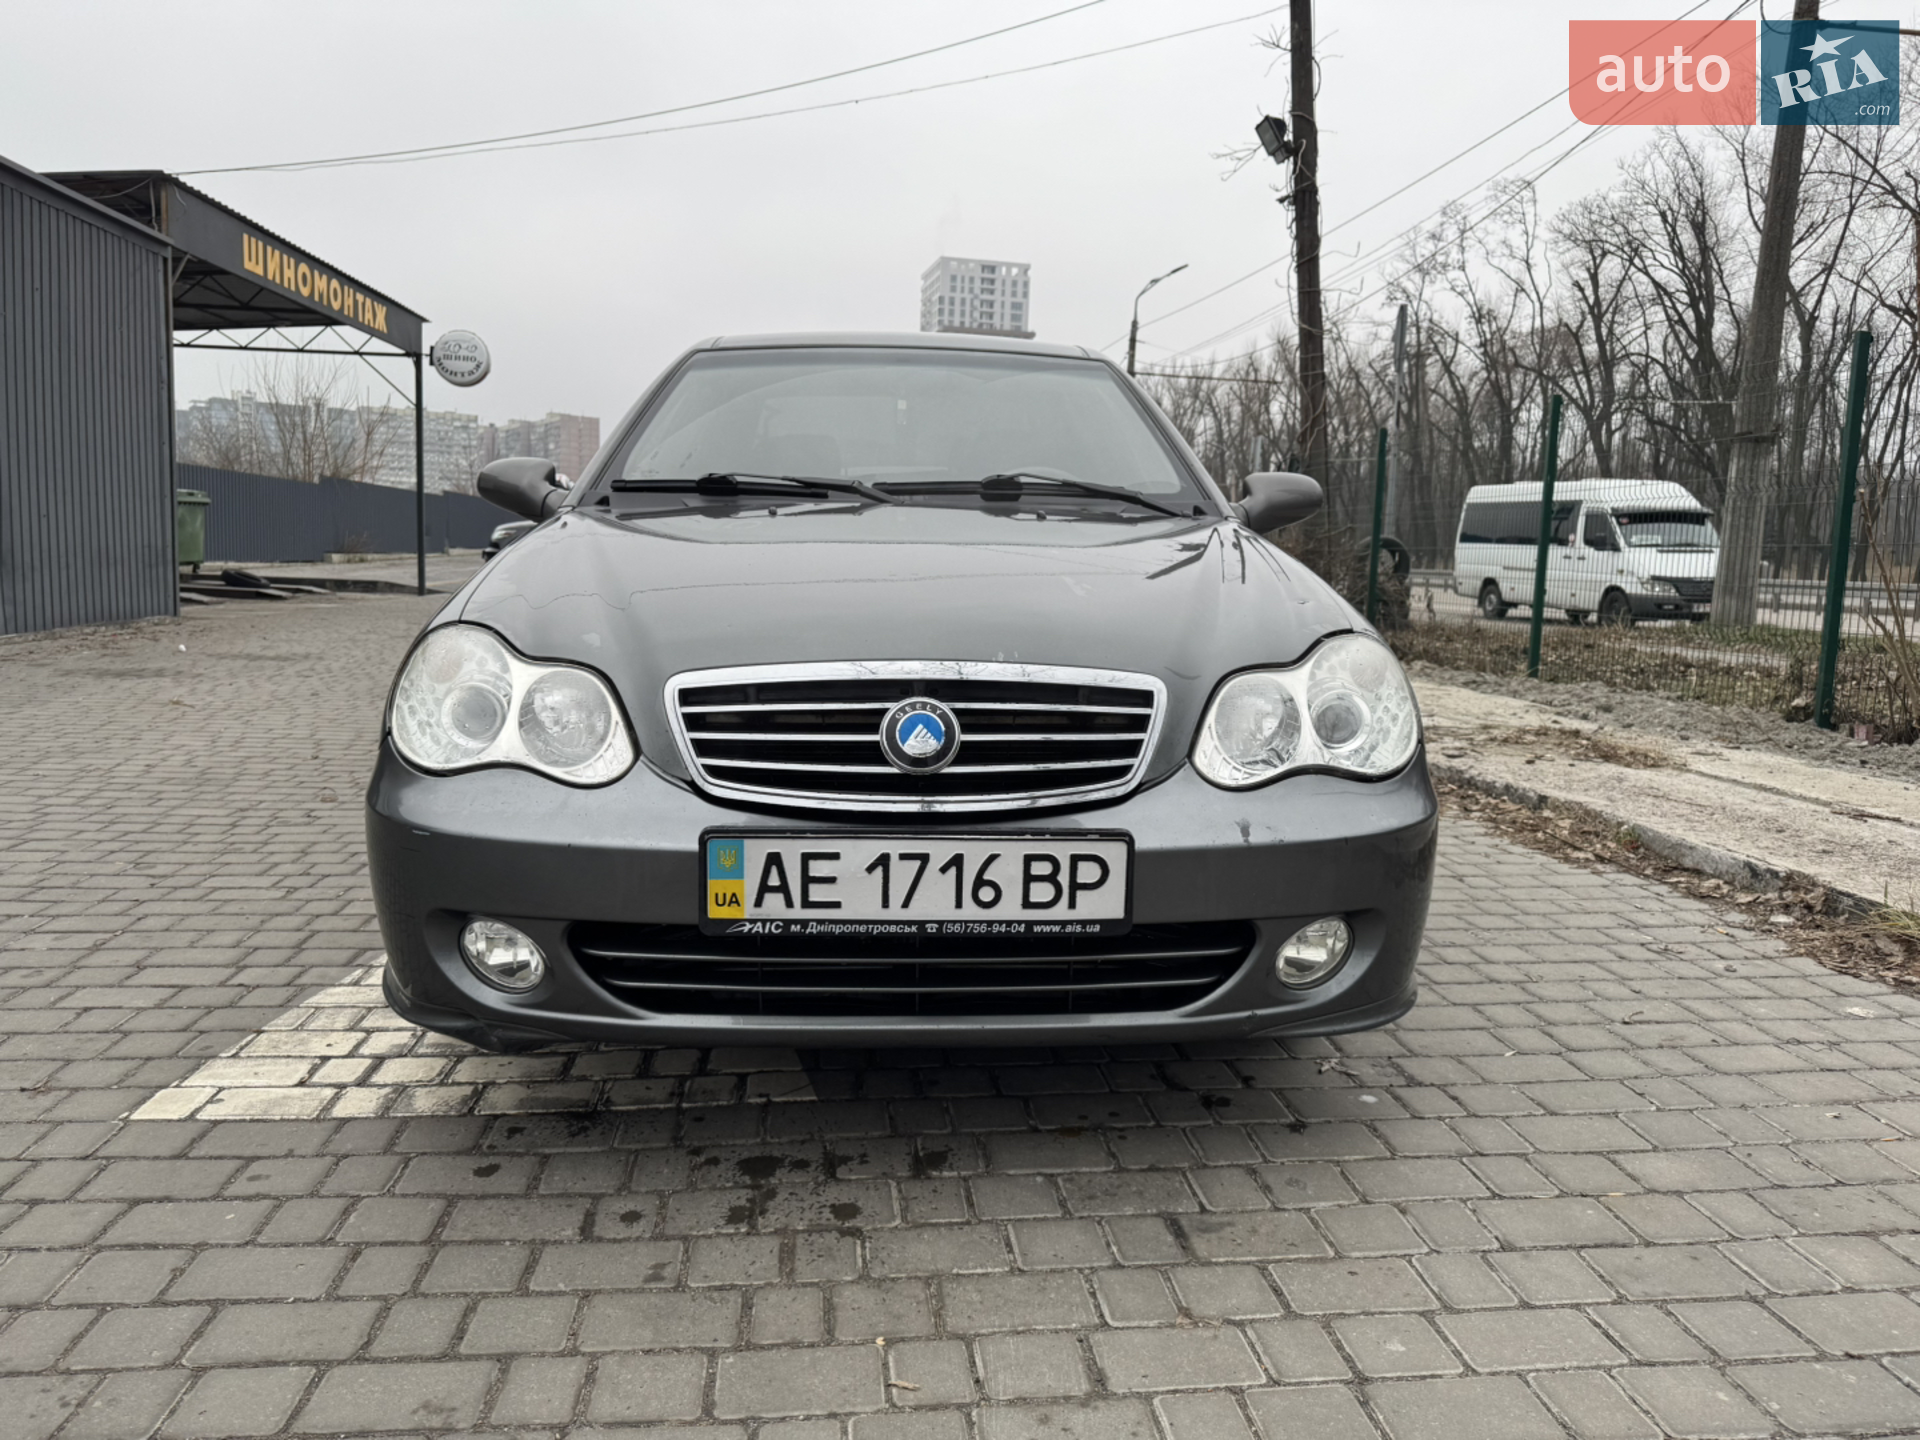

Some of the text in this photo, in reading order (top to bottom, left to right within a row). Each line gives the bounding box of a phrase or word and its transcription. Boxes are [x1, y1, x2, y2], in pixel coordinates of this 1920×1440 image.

[243, 232, 388, 334] ШИНОМОНТАЖ
[895, 702, 943, 719] GEELY
[753, 851, 1110, 910] AE 1716 BP
[715, 892, 741, 908] UA
[1033, 924, 1101, 934] www.ais.ua
